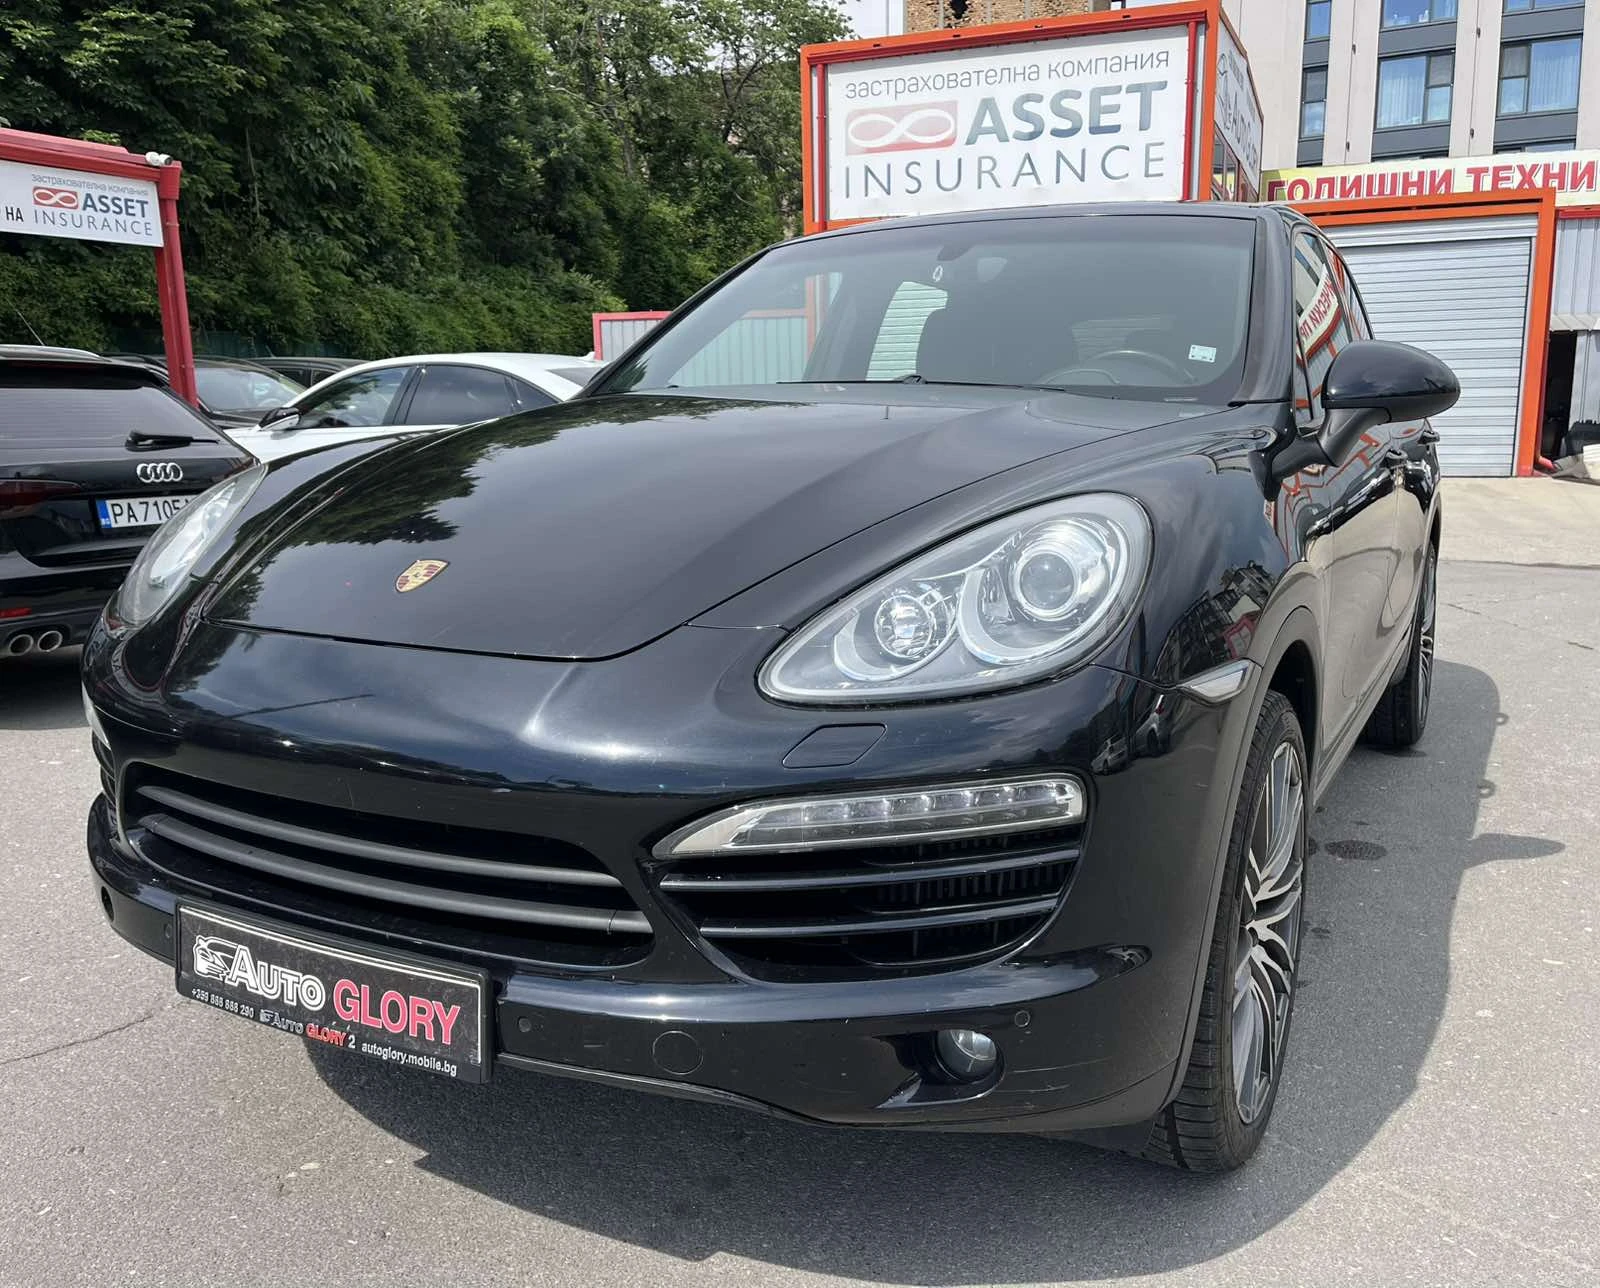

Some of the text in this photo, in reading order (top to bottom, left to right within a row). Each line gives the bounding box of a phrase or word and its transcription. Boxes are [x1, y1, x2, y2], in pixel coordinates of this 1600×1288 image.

[845, 49, 1170, 100] застрахователна компания
[965, 80, 1168, 146] ASSET
[844, 142, 1166, 199] INSURANCE
[1466, 159, 1599, 194] ТЕХНИ
[34, 209, 153, 237] INSURANCE
[82, 192, 149, 218] ASSET
[110, 498, 190, 524] PA7105
[225, 944, 461, 1045] AUTO GLORY
[271, 1012, 356, 1049] AUTO GLORY 2
[361, 1041, 457, 1077] autoglory.mobile.bg
